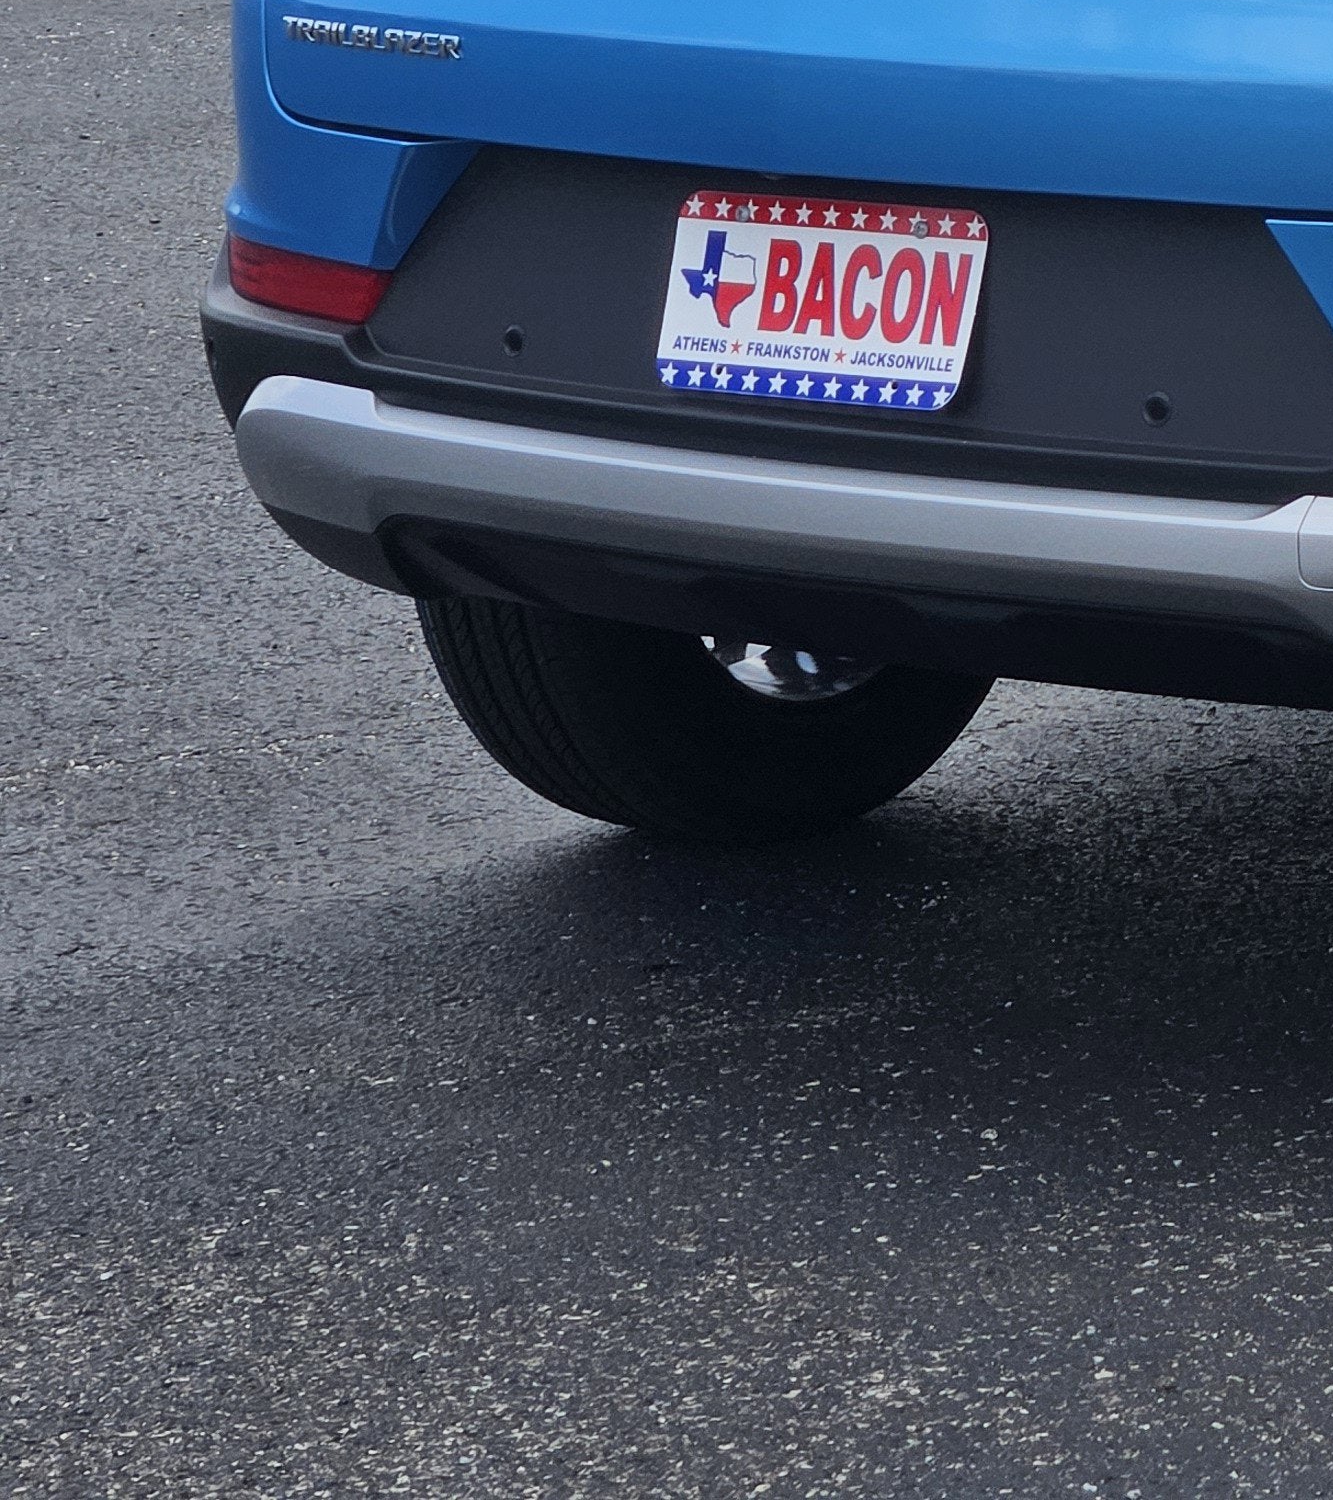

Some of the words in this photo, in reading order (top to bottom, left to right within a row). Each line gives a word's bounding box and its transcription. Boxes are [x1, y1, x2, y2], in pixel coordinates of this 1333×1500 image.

[282, 15, 464, 60] TRAILBLAZER
[757, 238, 974, 347] BACON
[672, 335, 727, 354] ATHENS
[746, 341, 830, 363] FRANKSTON
[850, 350, 955, 373] JACKSONVILLE
